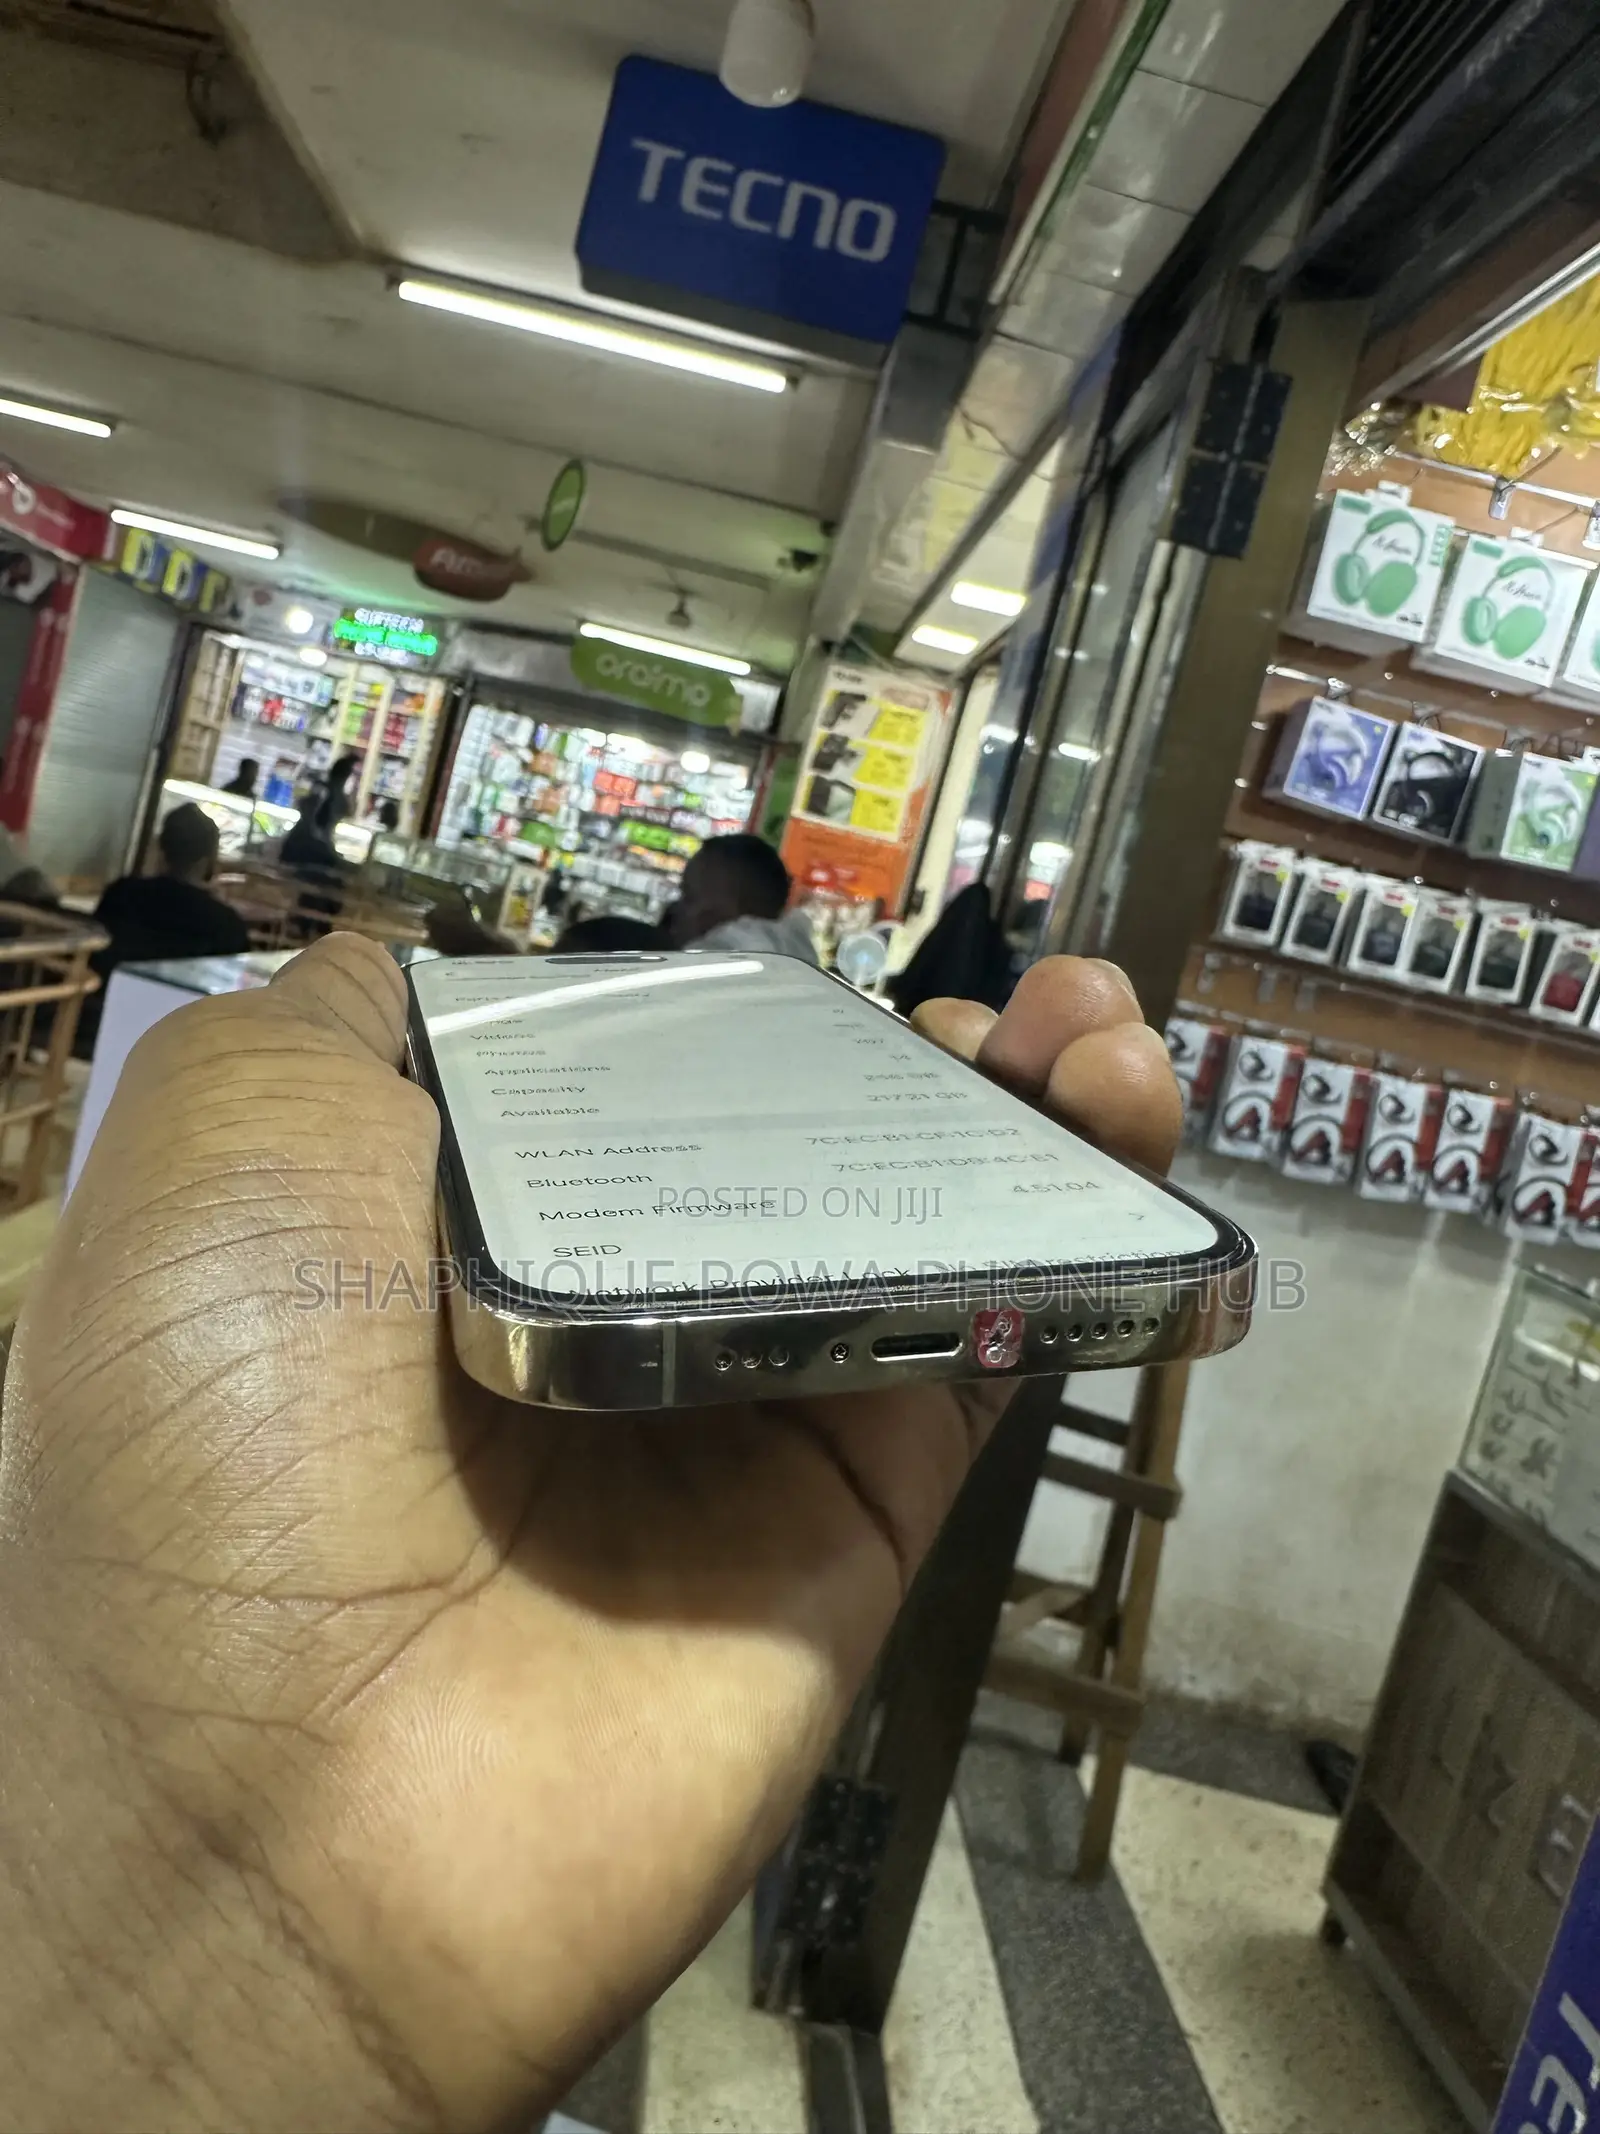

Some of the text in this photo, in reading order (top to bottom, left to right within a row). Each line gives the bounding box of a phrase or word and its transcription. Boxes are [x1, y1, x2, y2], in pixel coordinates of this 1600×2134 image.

[631, 138, 897, 263] TECNO
[596, 653, 711, 707] oraimo
[491, 1085, 586, 1096] Capacity
[501, 1106, 600, 1117] Available
[515, 1143, 702, 1158] WLAN Address
[527, 1174, 653, 1188] Bluetooth
[539, 1201, 776, 1221] Modem Firmware
[553, 1244, 622, 1258] SEID
